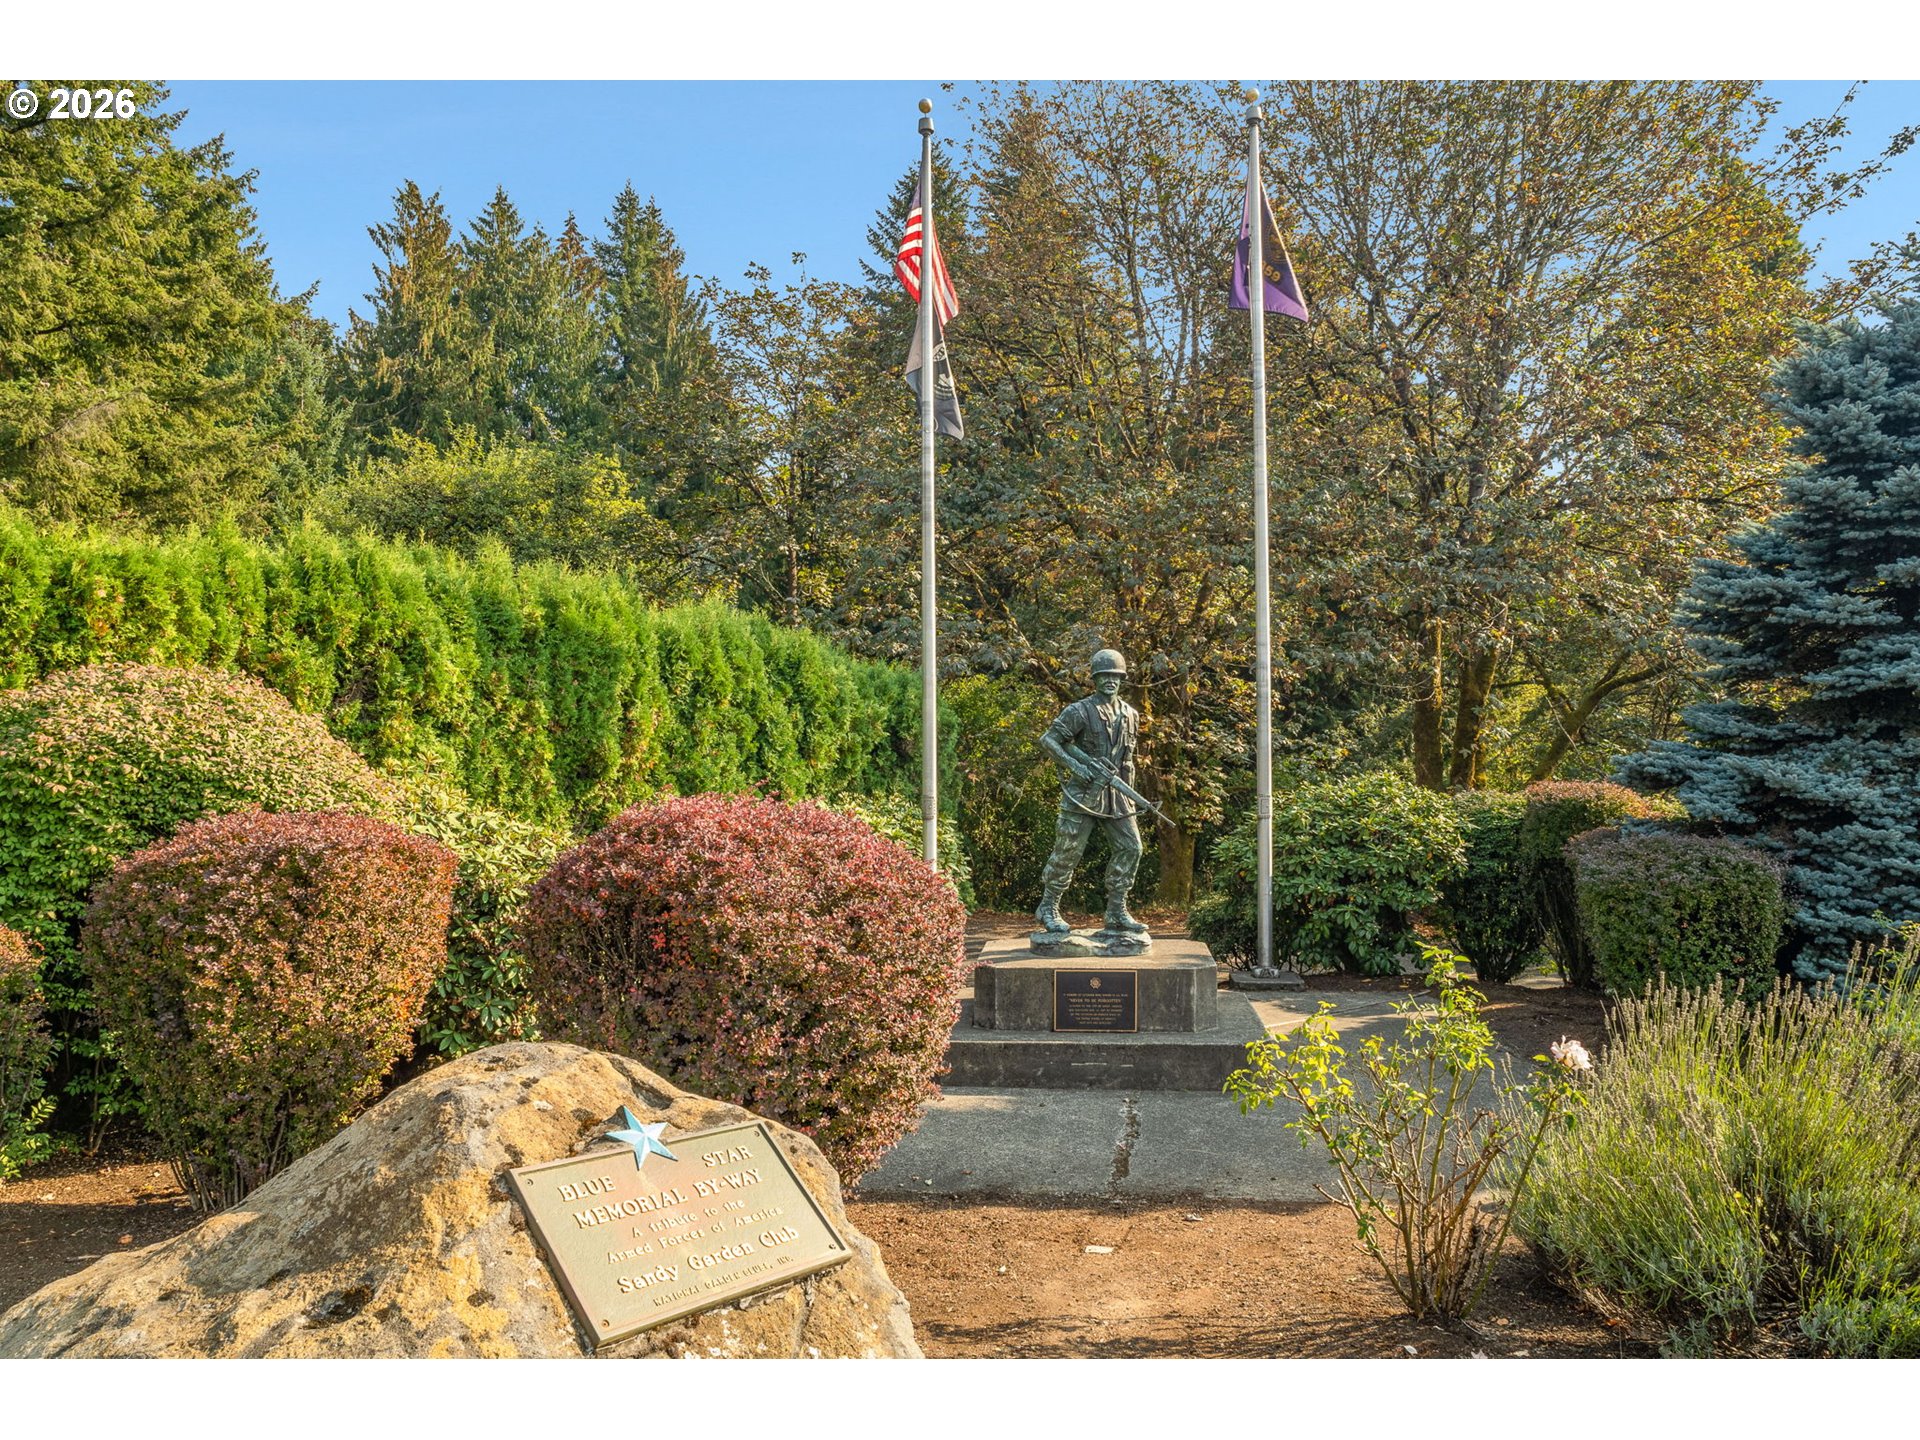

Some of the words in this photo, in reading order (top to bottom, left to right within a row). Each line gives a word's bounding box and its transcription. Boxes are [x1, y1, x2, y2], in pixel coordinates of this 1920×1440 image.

[558, 1175, 616, 1202] BLUE
[702, 1144, 754, 1167] STAR
[573, 1188, 688, 1229] MEMORIAL
[693, 1168, 763, 1198] BY-WAY
[607, 1244, 654, 1265] Armed
[659, 1229, 705, 1250] Forces
[711, 1218, 726, 1233] of
[734, 1205, 783, 1227] America
[632, 1227, 643, 1238] A
[650, 1212, 697, 1233] tribute
[704, 1206, 718, 1217] to
[723, 1198, 745, 1211] the
[617, 1263, 679, 1294] Sandy
[687, 1240, 755, 1270] Garden
[758, 1226, 800, 1248] Club
[653, 1286, 701, 1307] NATIONAL
[705, 1271, 740, 1289] GARDEN
